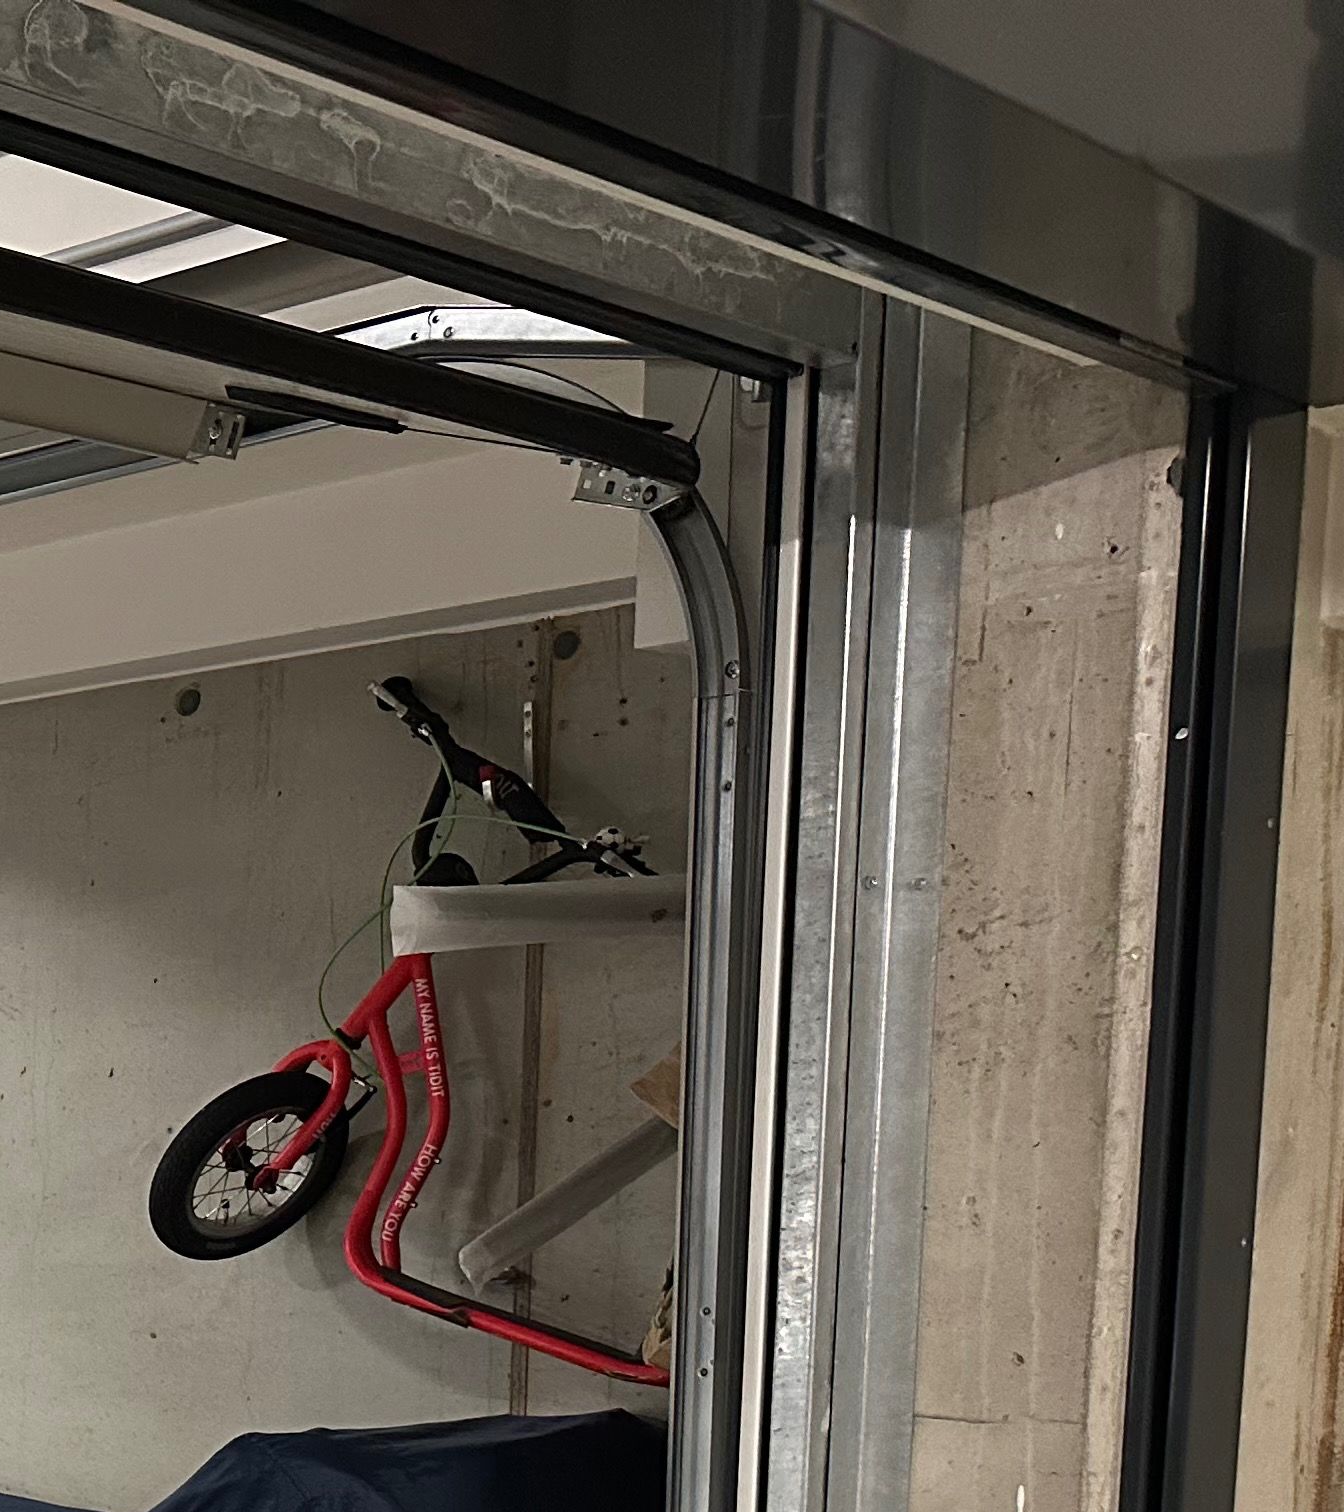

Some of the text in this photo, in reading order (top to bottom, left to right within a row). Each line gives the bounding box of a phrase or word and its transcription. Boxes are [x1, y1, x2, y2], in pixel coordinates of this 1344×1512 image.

[415, 978, 445, 1097] MY NAME IS TIDIT
[381, 1144, 438, 1242] HOW ARE YOU
